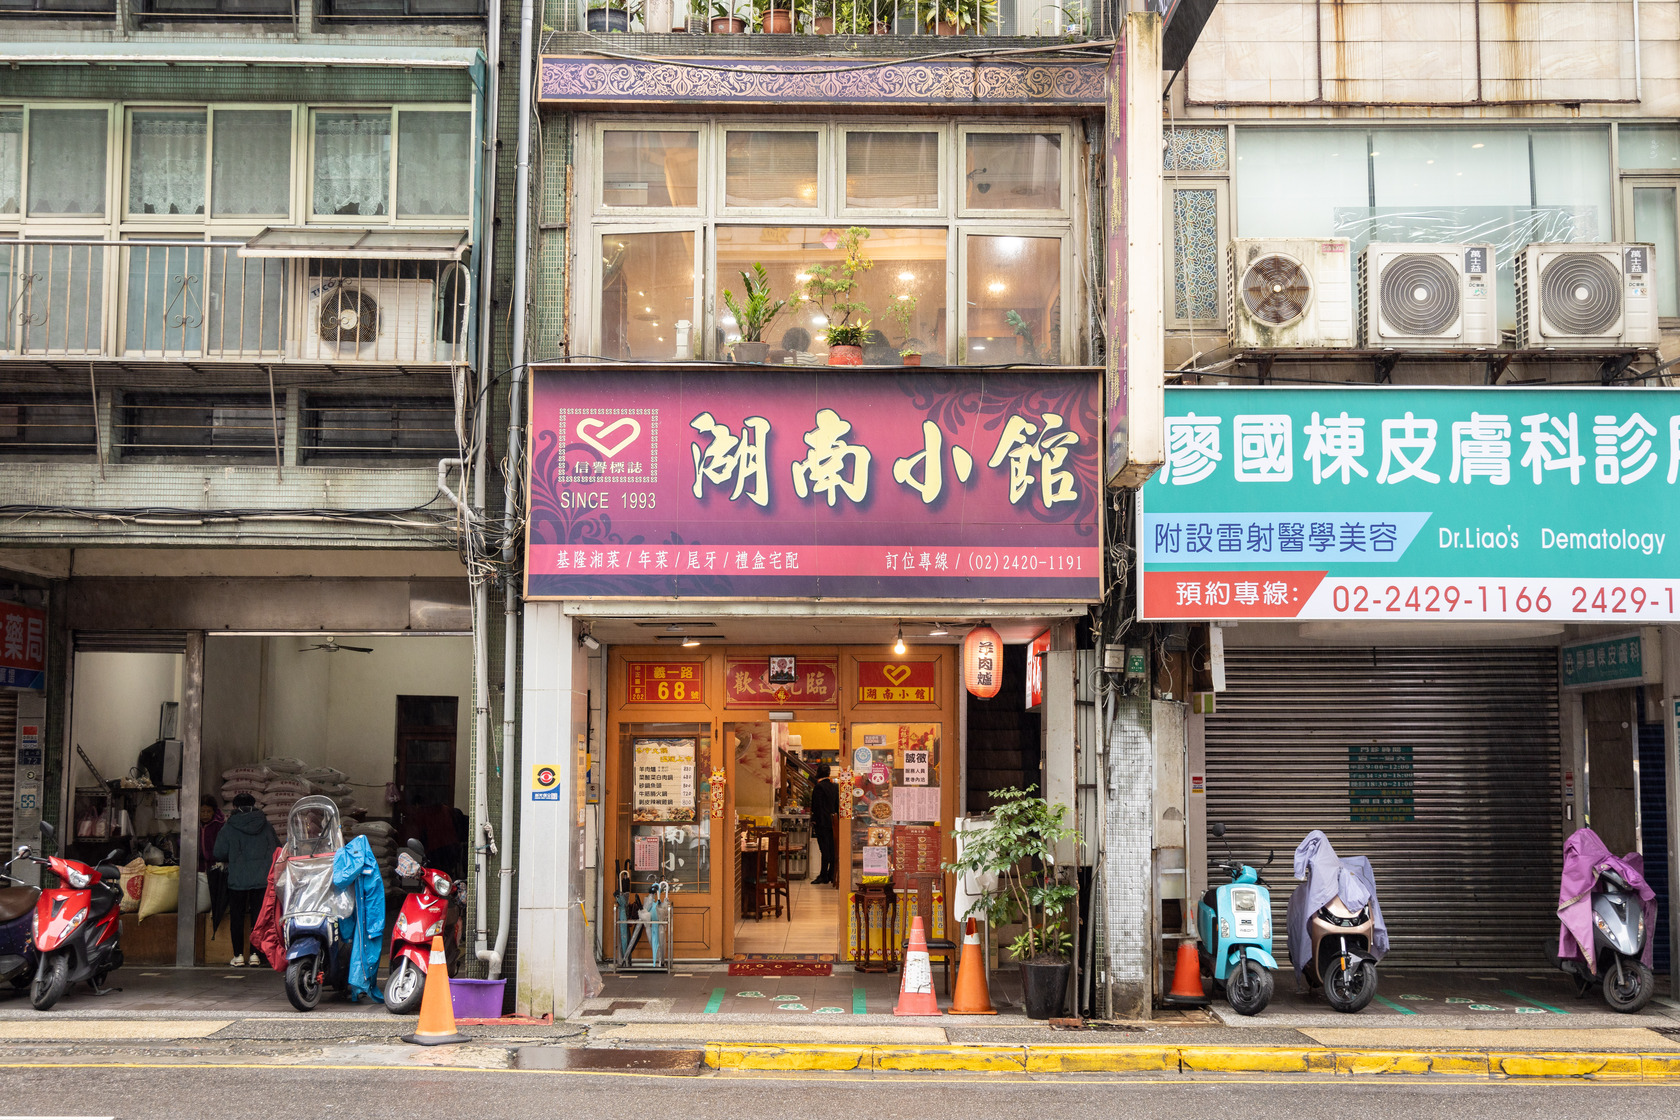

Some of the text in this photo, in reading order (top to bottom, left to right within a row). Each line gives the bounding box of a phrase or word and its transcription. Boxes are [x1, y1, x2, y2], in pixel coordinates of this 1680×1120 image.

[1470, 250, 1481, 272] 萬士益
[1630, 250, 1642, 272] 萬士益
[689, 409, 1080, 508] 湖南小館
[1159, 411, 1680, 485] 廖國棟皮膚科診
[574, 460, 643, 474] 信譽標誌
[560, 492, 656, 509] SINCE 1993
[1155, 521, 1398, 553] 附設雷射醫學美容
[1438, 525, 1666, 555] Dr.Liao's Dematology
[1175, 580, 1299, 606] 預約專線:
[1332, 585, 1552, 613] 02-2429-1166
[733, 671, 828, 694] 歡臨
[866, 688, 926, 700] 湖南小館
